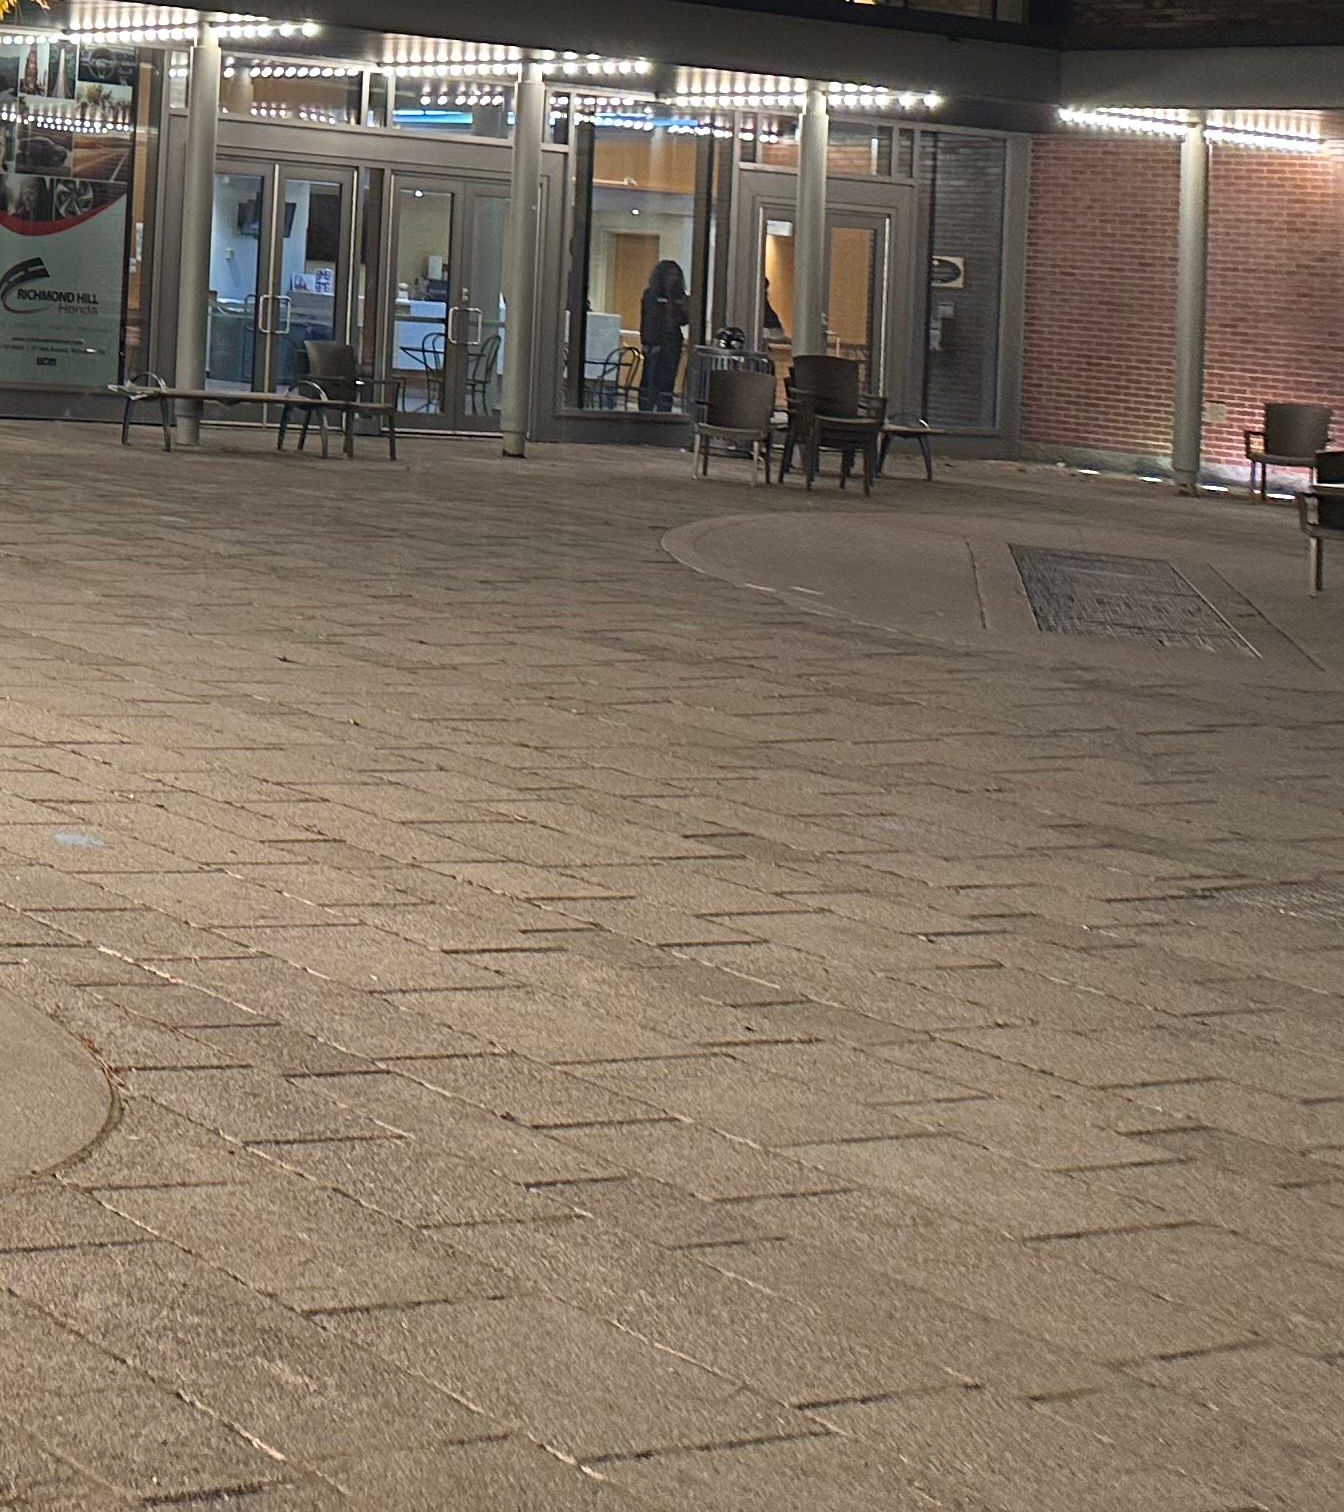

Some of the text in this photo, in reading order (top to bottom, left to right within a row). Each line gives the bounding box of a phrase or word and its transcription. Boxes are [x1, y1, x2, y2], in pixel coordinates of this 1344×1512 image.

[17, 289, 99, 305] RICHMOND HILL
[58, 304, 99, 316] Honda
